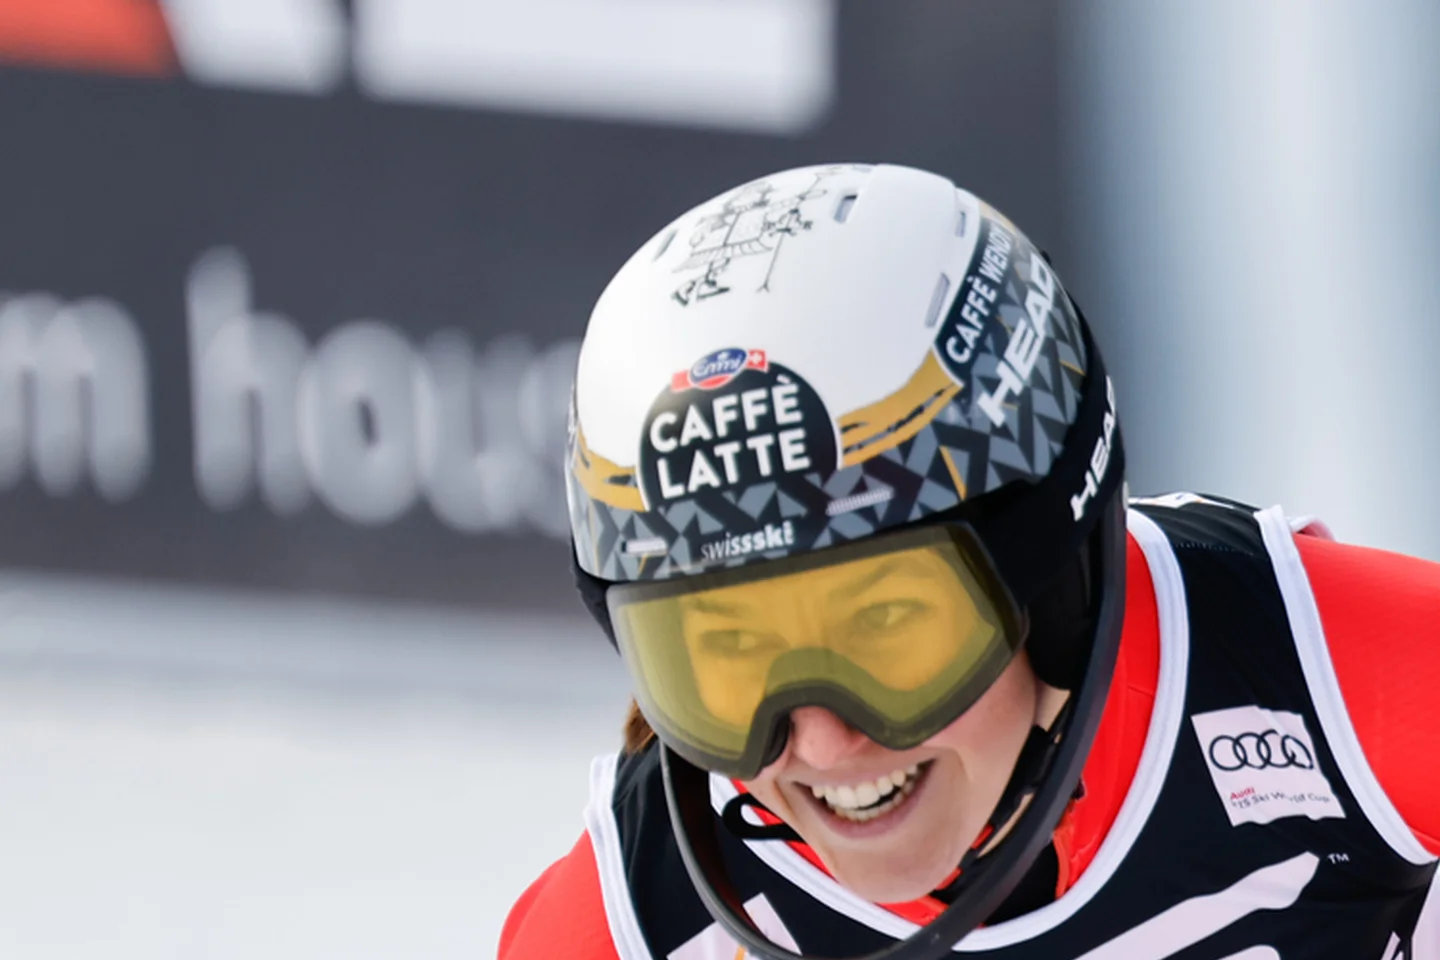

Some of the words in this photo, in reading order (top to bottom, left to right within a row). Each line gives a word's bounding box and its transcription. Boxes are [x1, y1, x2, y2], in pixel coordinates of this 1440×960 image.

[945, 275, 998, 364] CAFFÈ
[977, 252, 1056, 428] HEAD
[691, 355, 742, 377] Emmi
[648, 374, 803, 454] CAFFÈ
[656, 428, 812, 498] LATTE
[1230, 787, 1256, 800] Audi
